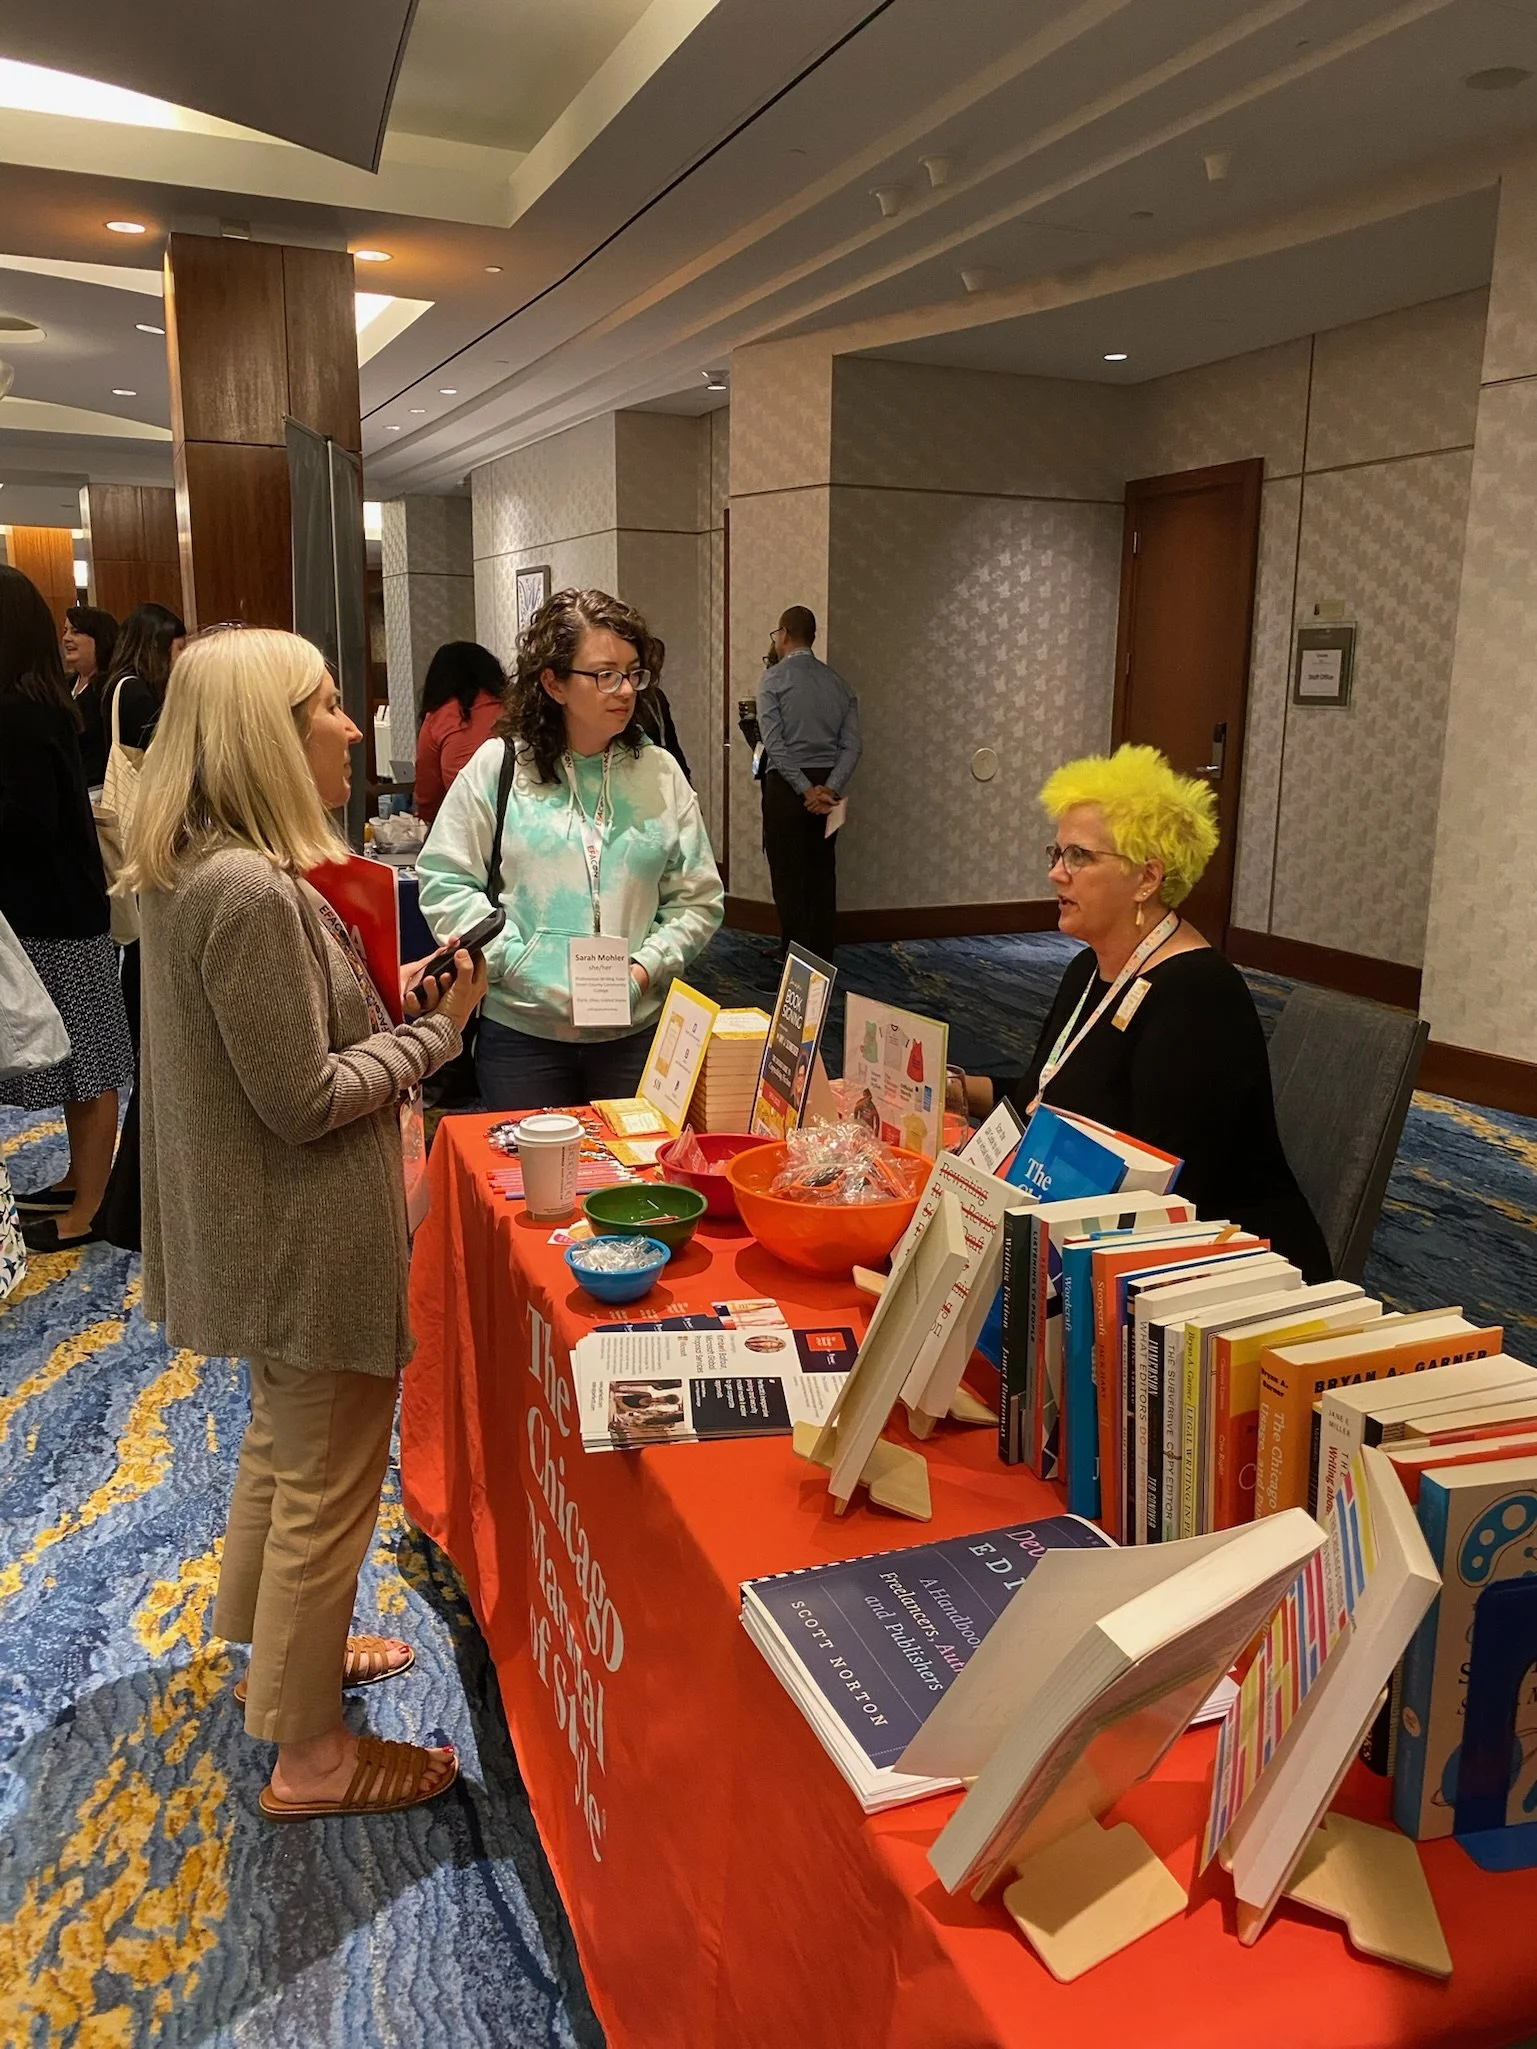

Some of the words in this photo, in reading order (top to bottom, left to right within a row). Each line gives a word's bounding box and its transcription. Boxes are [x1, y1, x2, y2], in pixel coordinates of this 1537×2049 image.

[587, 845, 599, 879] EFACON
[782, 1004, 803, 1029] SIGNING
[785, 989, 803, 1012] BOOK
[938, 1162, 989, 1206] Rewriting
[1027, 1158, 1052, 1191] The
[1003, 1236, 1013, 1282] Writing
[1002, 1286, 1012, 1329] Fiction
[1030, 1288, 1037, 1300] TO
[1064, 1276, 1072, 1331] Wordcraft
[1097, 1281, 1105, 1336] Storycraft
[706, 1335, 715, 1354] Microsoft
[1139, 1321, 1148, 1360] WHAT
[1167, 1344, 1175, 1367] THE
[527, 1300, 570, 1437] The
[696, 1354, 704, 1374] Services
[707, 1355, 716, 1370] Global
[1001, 1346, 1010, 1379] Janet
[1148, 1339, 1159, 1397] IMMERSION
[1314, 1370, 1376, 1394] BRYAN
[1415, 1350, 1488, 1373] GARNER
[1099, 1373, 1107, 1399] HART
[1139, 1364, 1147, 1421] EDITORS
[1166, 1370, 1175, 1436] SUBVERSIVE
[1262, 1379, 1285, 1398] Garner
[1279, 1379, 1289, 1389] A.
[1139, 1426, 1147, 1446] DO
[1185, 1407, 1193, 1445] LEGAL
[1272, 1411, 1286, 1442] The
[1329, 1411, 1344, 1423] JANE
[1329, 1420, 1351, 1437] MILLER
[1165, 1441, 1175, 1475] COPY
[1184, 1448, 1193, 1502] WRITING
[1325, 1446, 1338, 1485] Writing
[1148, 1475, 1157, 1490] TED
[1267, 1446, 1284, 1509] Chicago
[1147, 1491, 1156, 1529] CONOVER
[1165, 1476, 1174, 1520] EDITOR
[1184, 1505, 1192, 1519] IN
[1325, 1486, 1335, 1515] abou
[527, 1406, 624, 1673] Chicago
[1005, 1528, 1048, 1558] Dev
[919, 1577, 938, 1589] A
[968, 1542, 1026, 1591] EDI
[878, 1570, 940, 1643] Freelancers,
[927, 1588, 983, 1650] Handboo
[526, 1489, 606, 1777] Manual
[529, 1602, 551, 1688] of
[864, 1594, 888, 1620] and
[884, 1621, 944, 1692] Publishers
[790, 1600, 834, 1650] SCOTT
[829, 1656, 888, 1728] NORTON
[553, 1654, 602, 1863] Style
